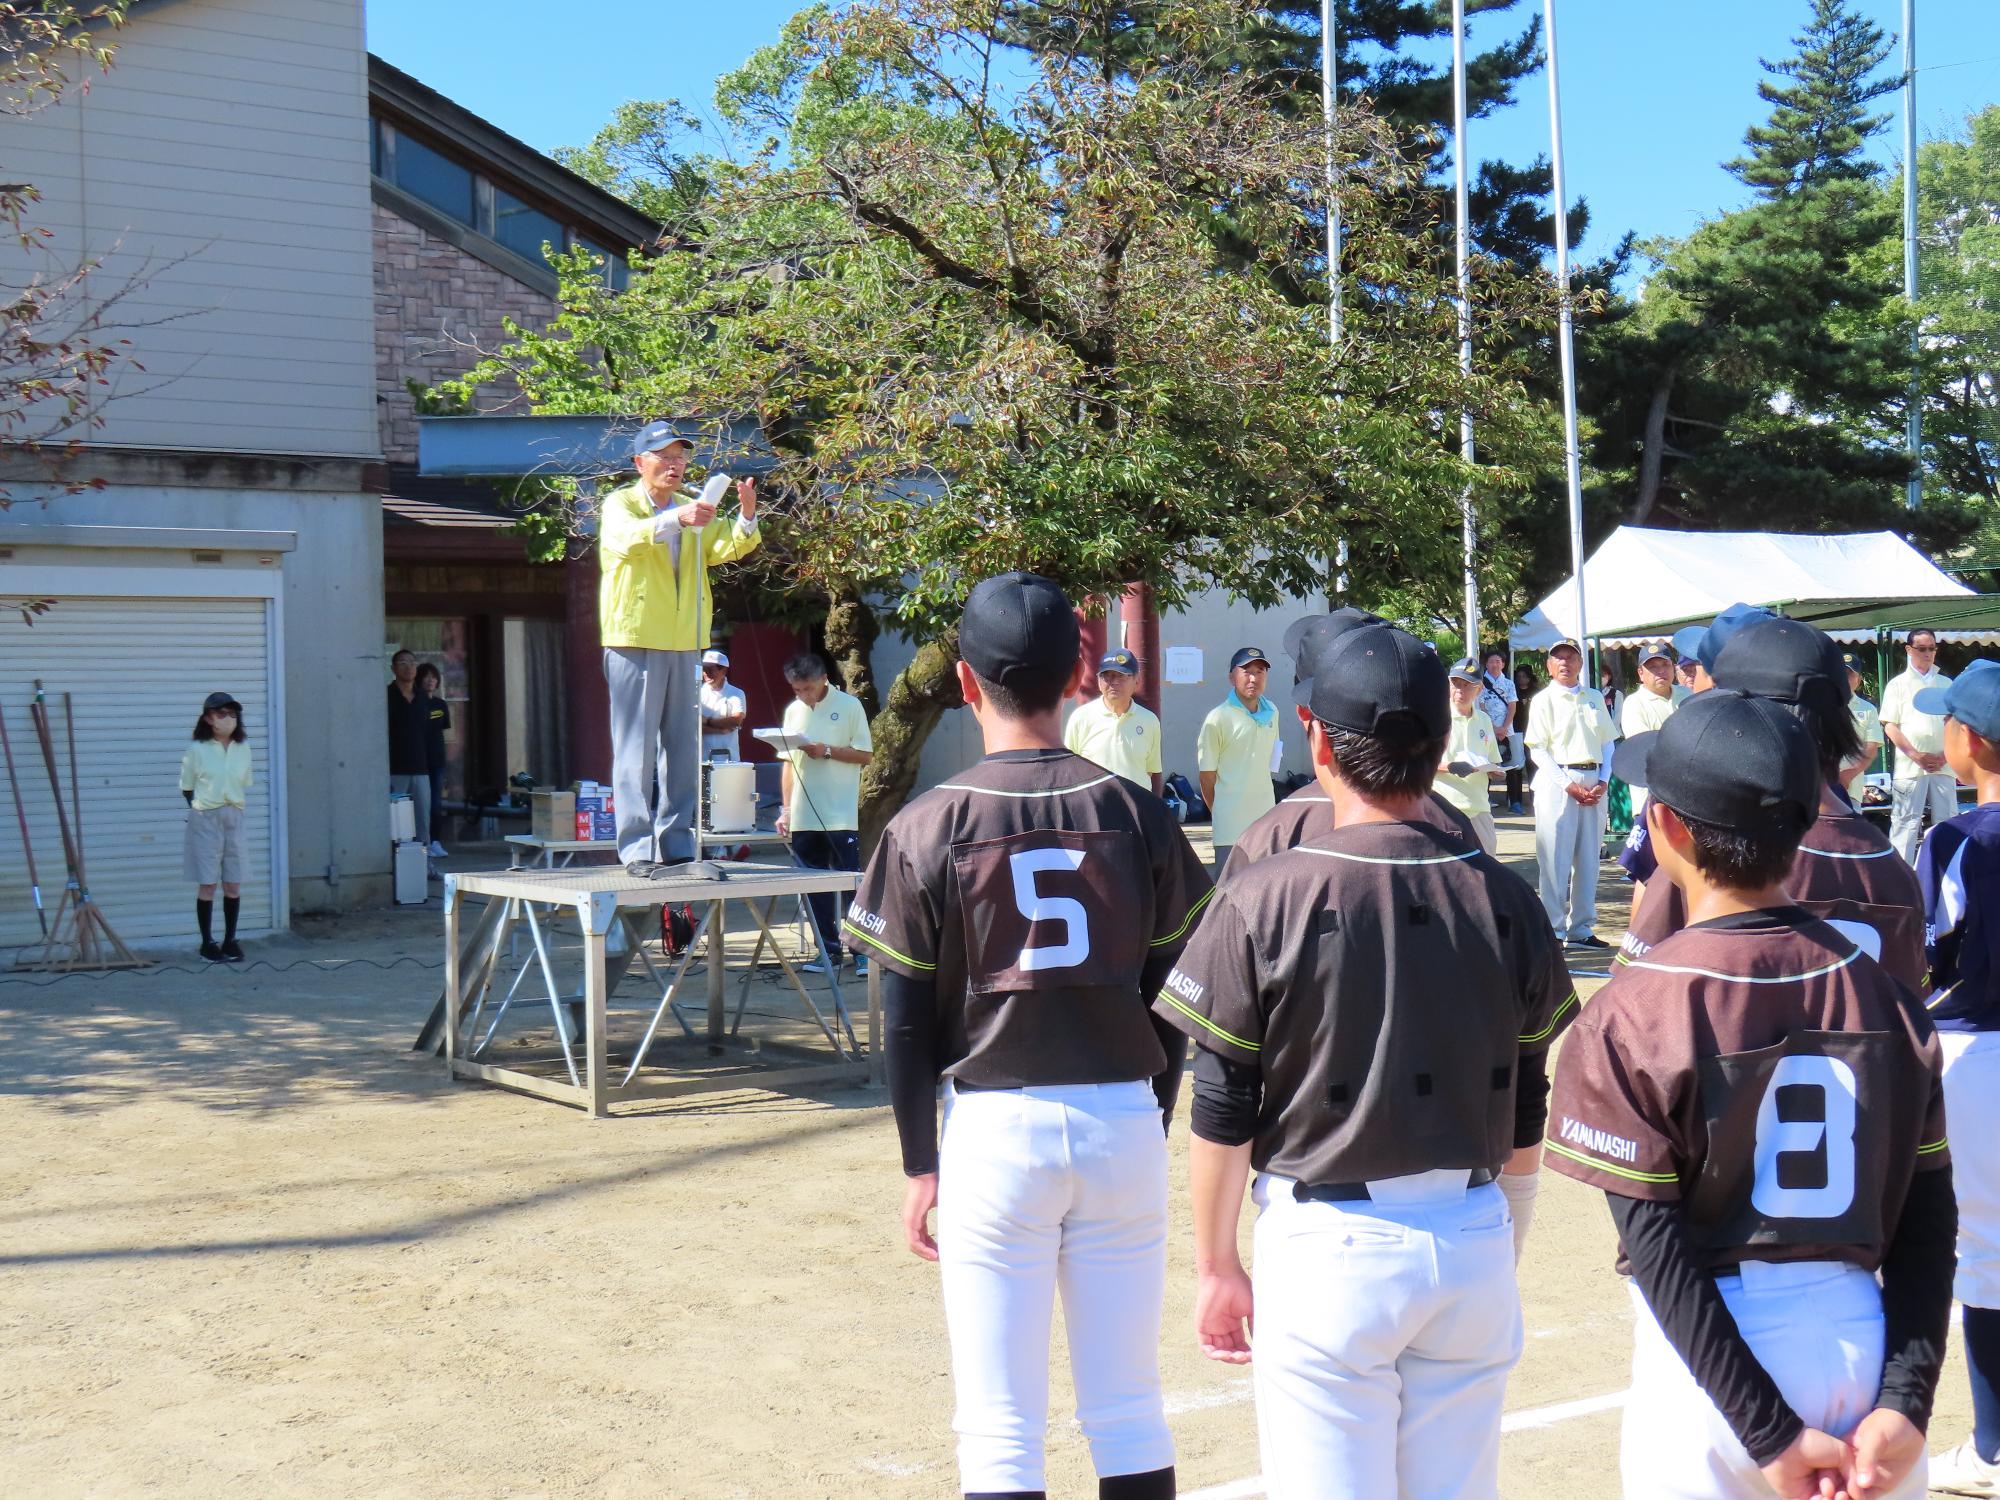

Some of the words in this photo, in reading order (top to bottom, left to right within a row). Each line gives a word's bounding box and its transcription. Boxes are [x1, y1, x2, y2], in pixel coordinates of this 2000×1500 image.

[1009, 848, 1090, 972] 5
[1560, 1116, 1637, 1162] YAMANASHI
[1751, 1055, 1856, 1218] 8
